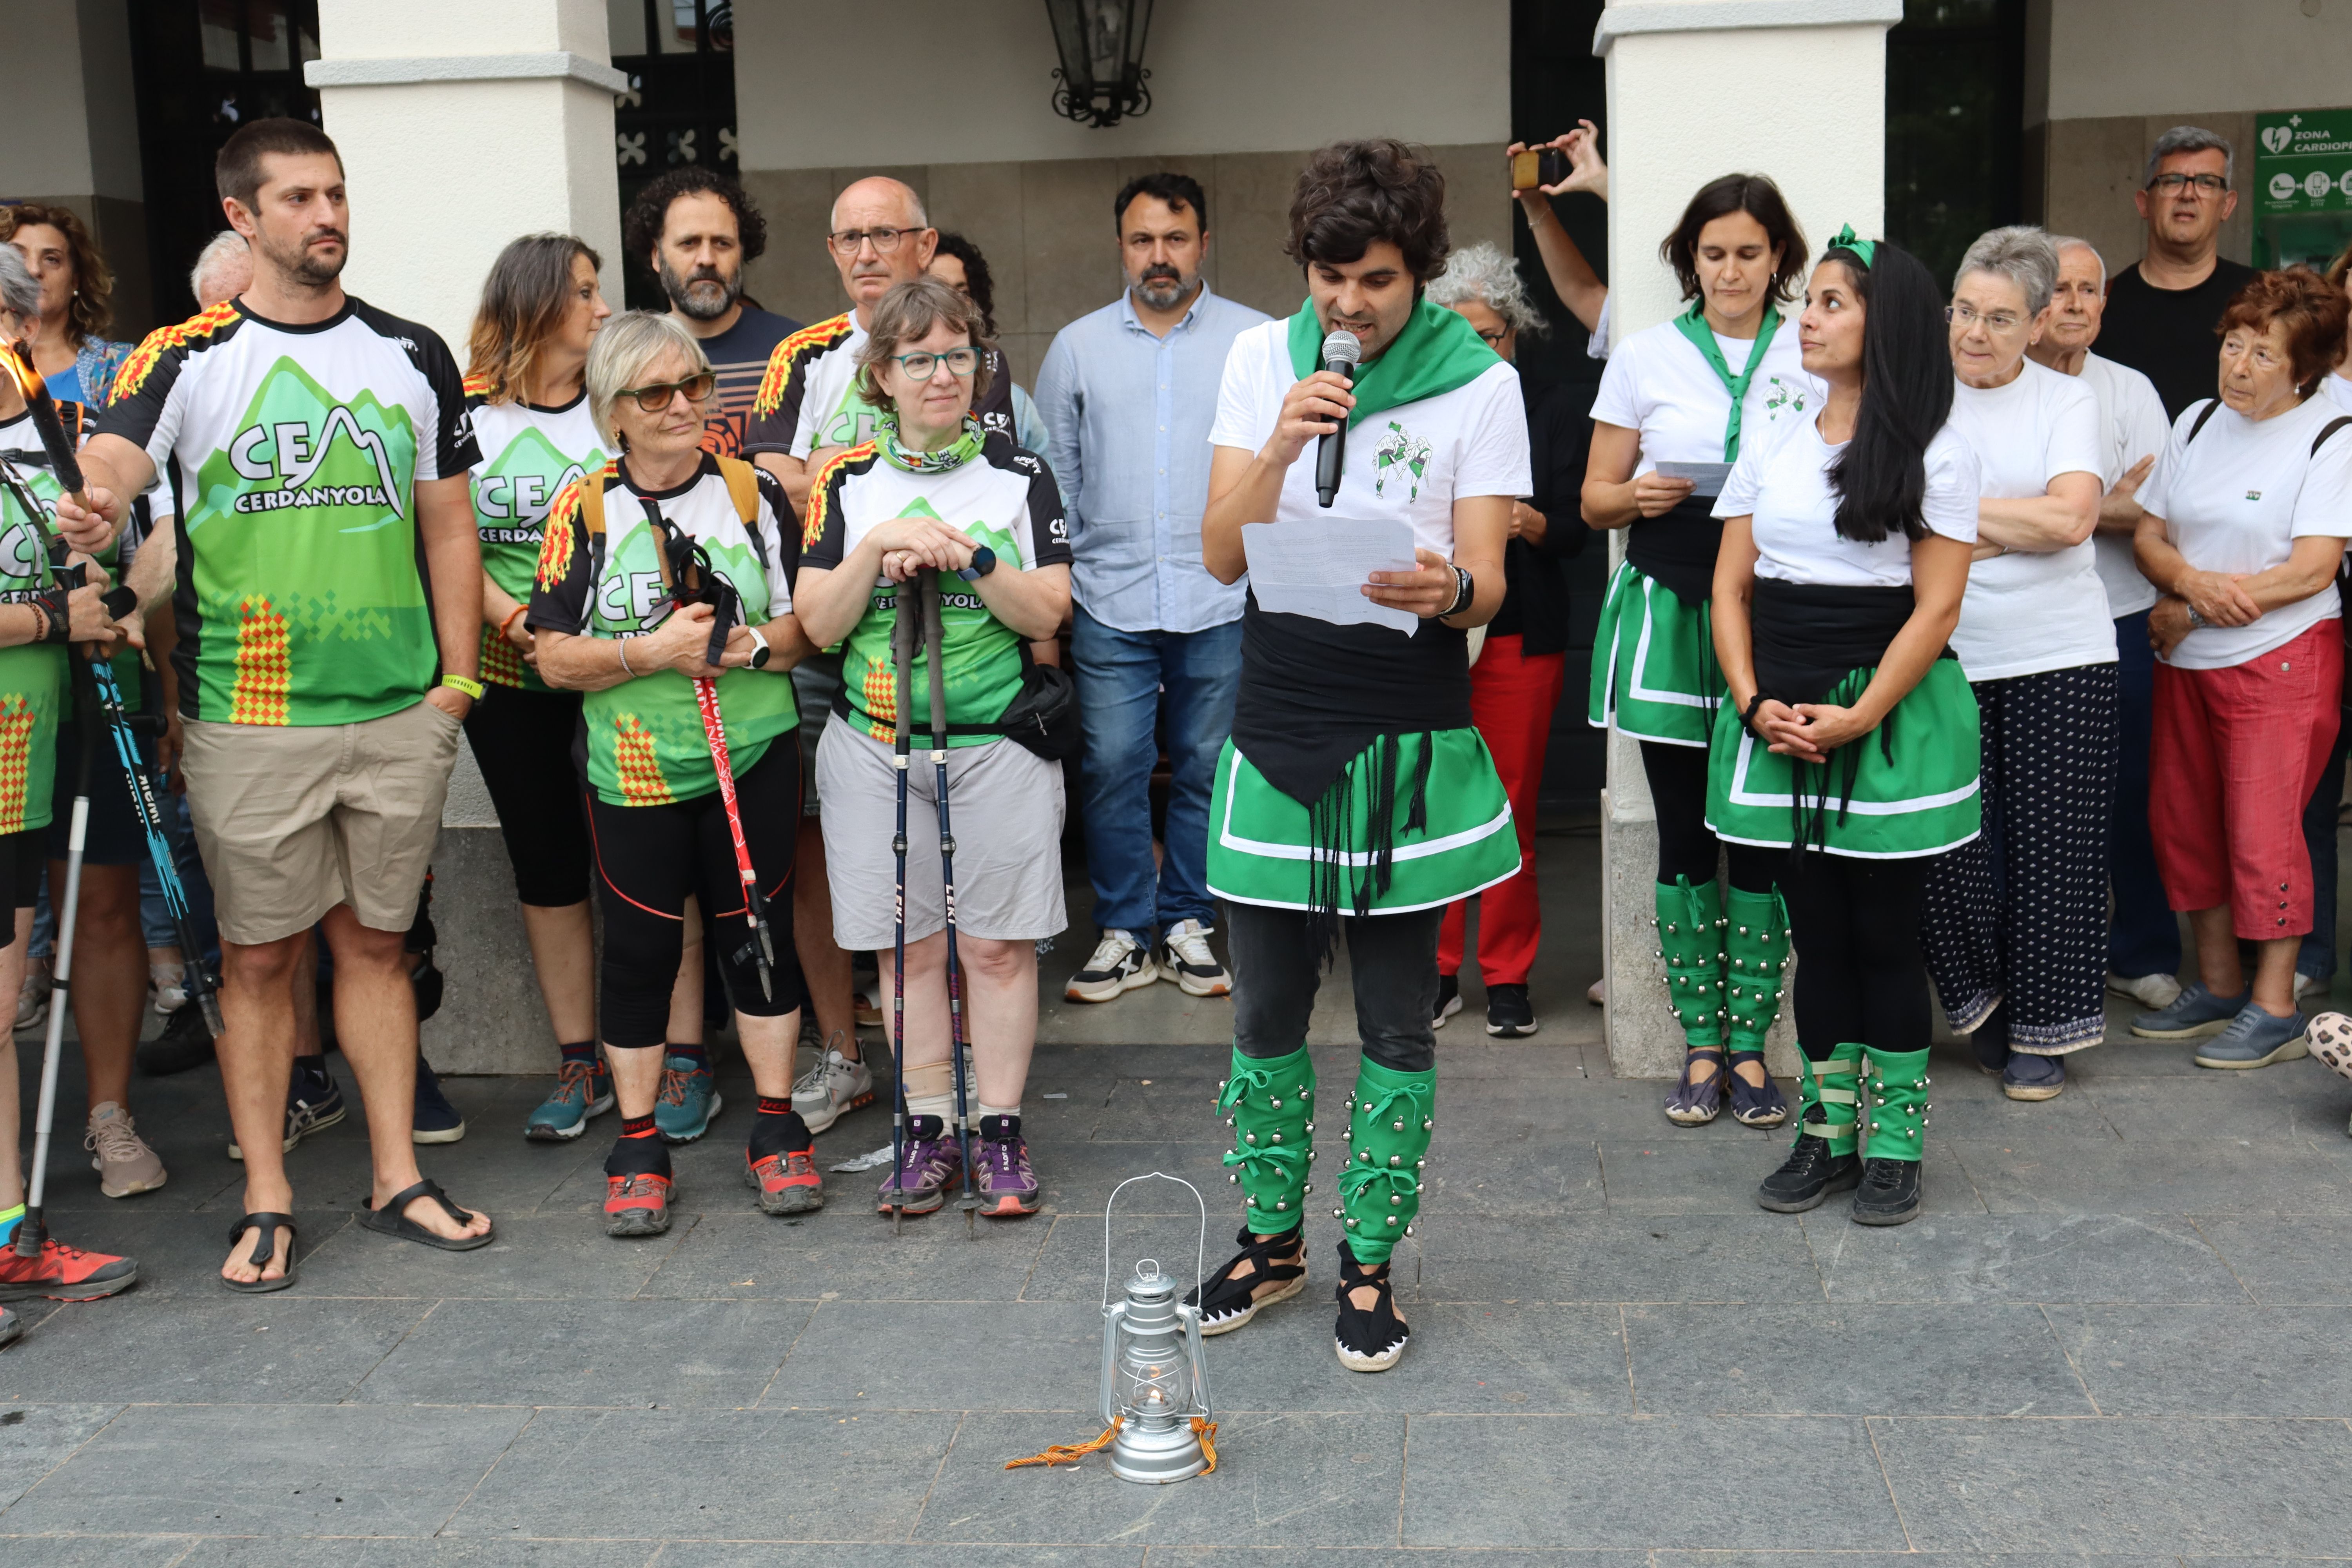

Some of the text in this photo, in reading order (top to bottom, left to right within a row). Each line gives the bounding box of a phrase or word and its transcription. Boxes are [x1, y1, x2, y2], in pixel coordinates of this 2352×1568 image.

[2295, 130, 2330, 140] ZONA
[235, 486, 390, 513] CERDANYOLA
[945, 884, 956, 924] LEKI
